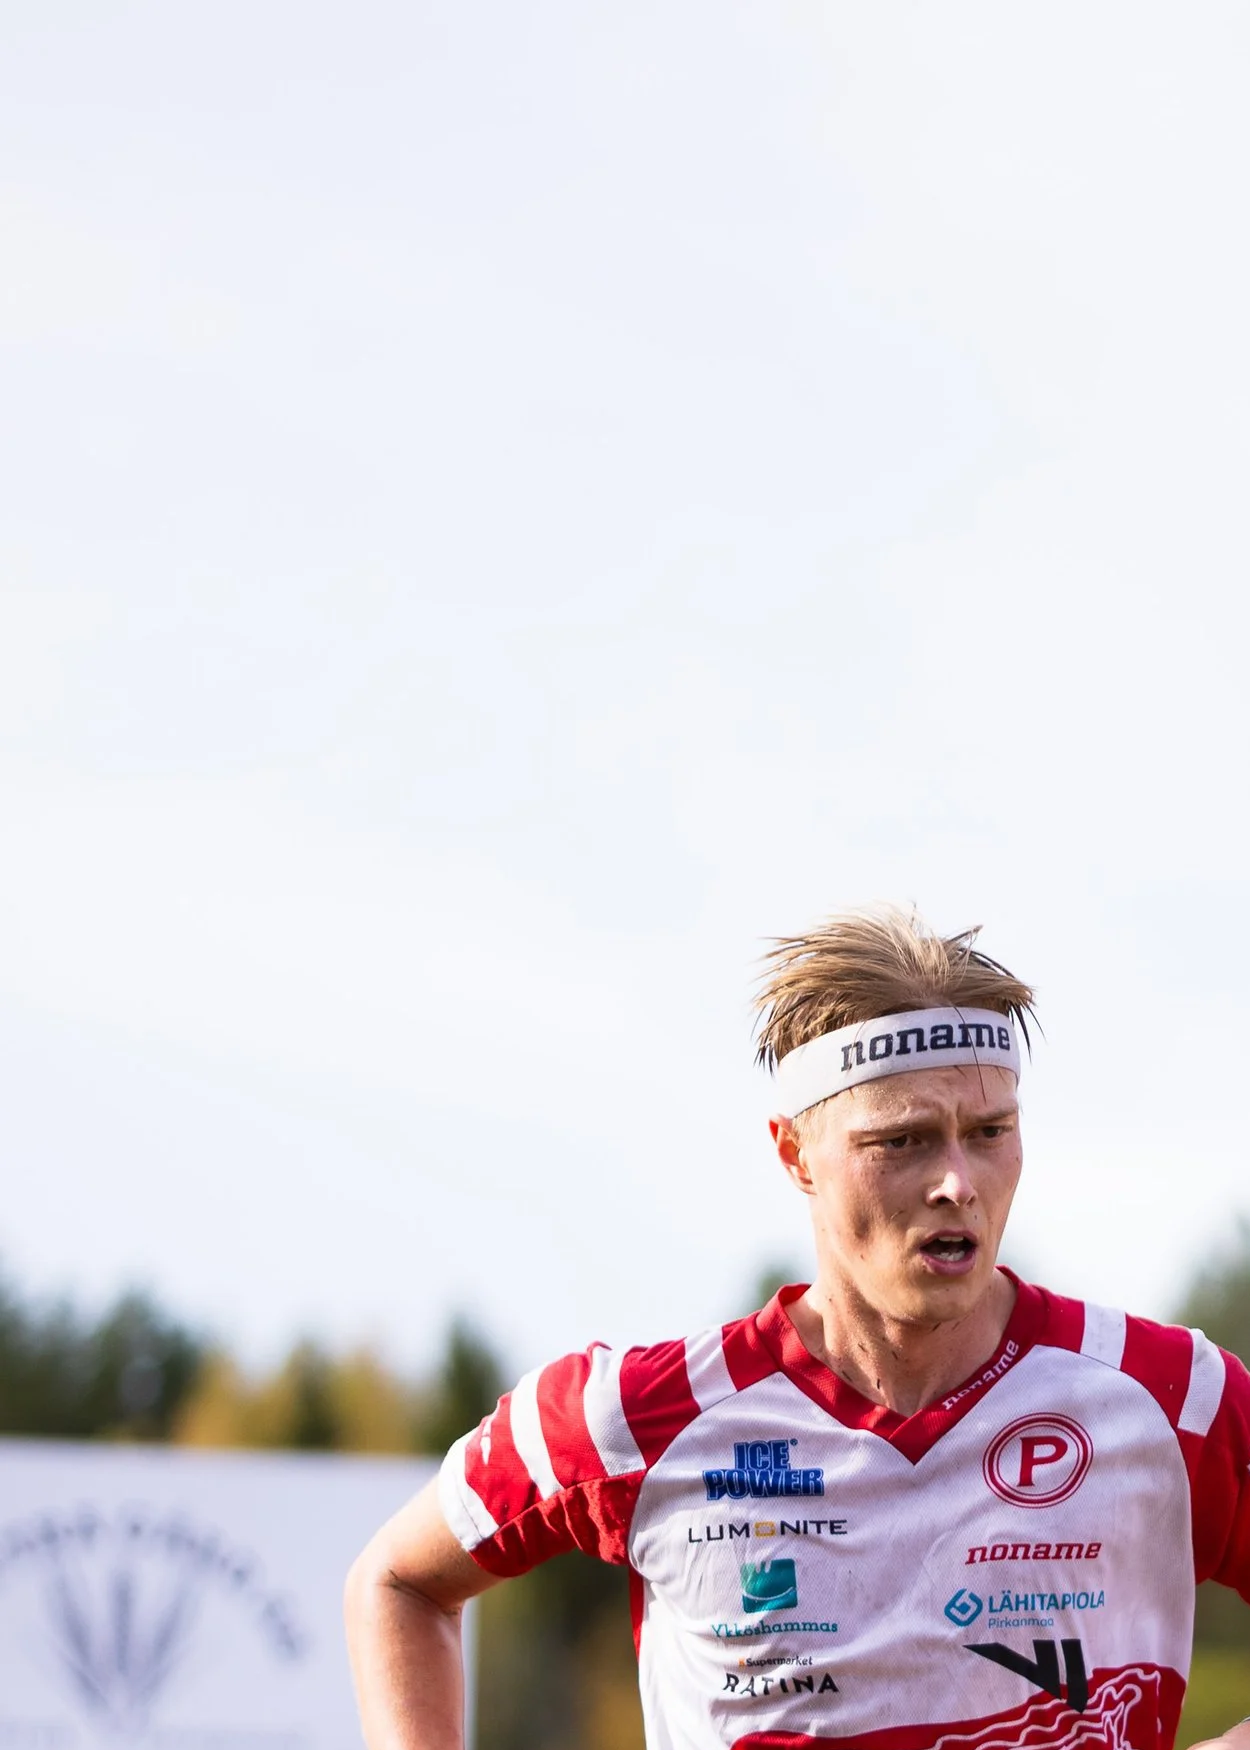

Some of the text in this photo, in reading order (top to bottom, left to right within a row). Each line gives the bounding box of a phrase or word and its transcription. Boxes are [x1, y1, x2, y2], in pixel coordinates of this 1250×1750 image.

[841, 1022, 1011, 1072] noname
[734, 1440, 791, 1470] ICE
[1016, 1435, 1068, 1488] P
[703, 1467, 825, 1501] POWER
[688, 1519, 848, 1543] LUMONITE
[964, 1542, 1102, 1566] noname
[988, 1590, 1105, 1614] LÄHITAPIOLA
[711, 1619, 839, 1638] Ykköshammas
[988, 1616, 1054, 1629] Pirkanmaa
[722, 1672, 840, 1697] RATINA
